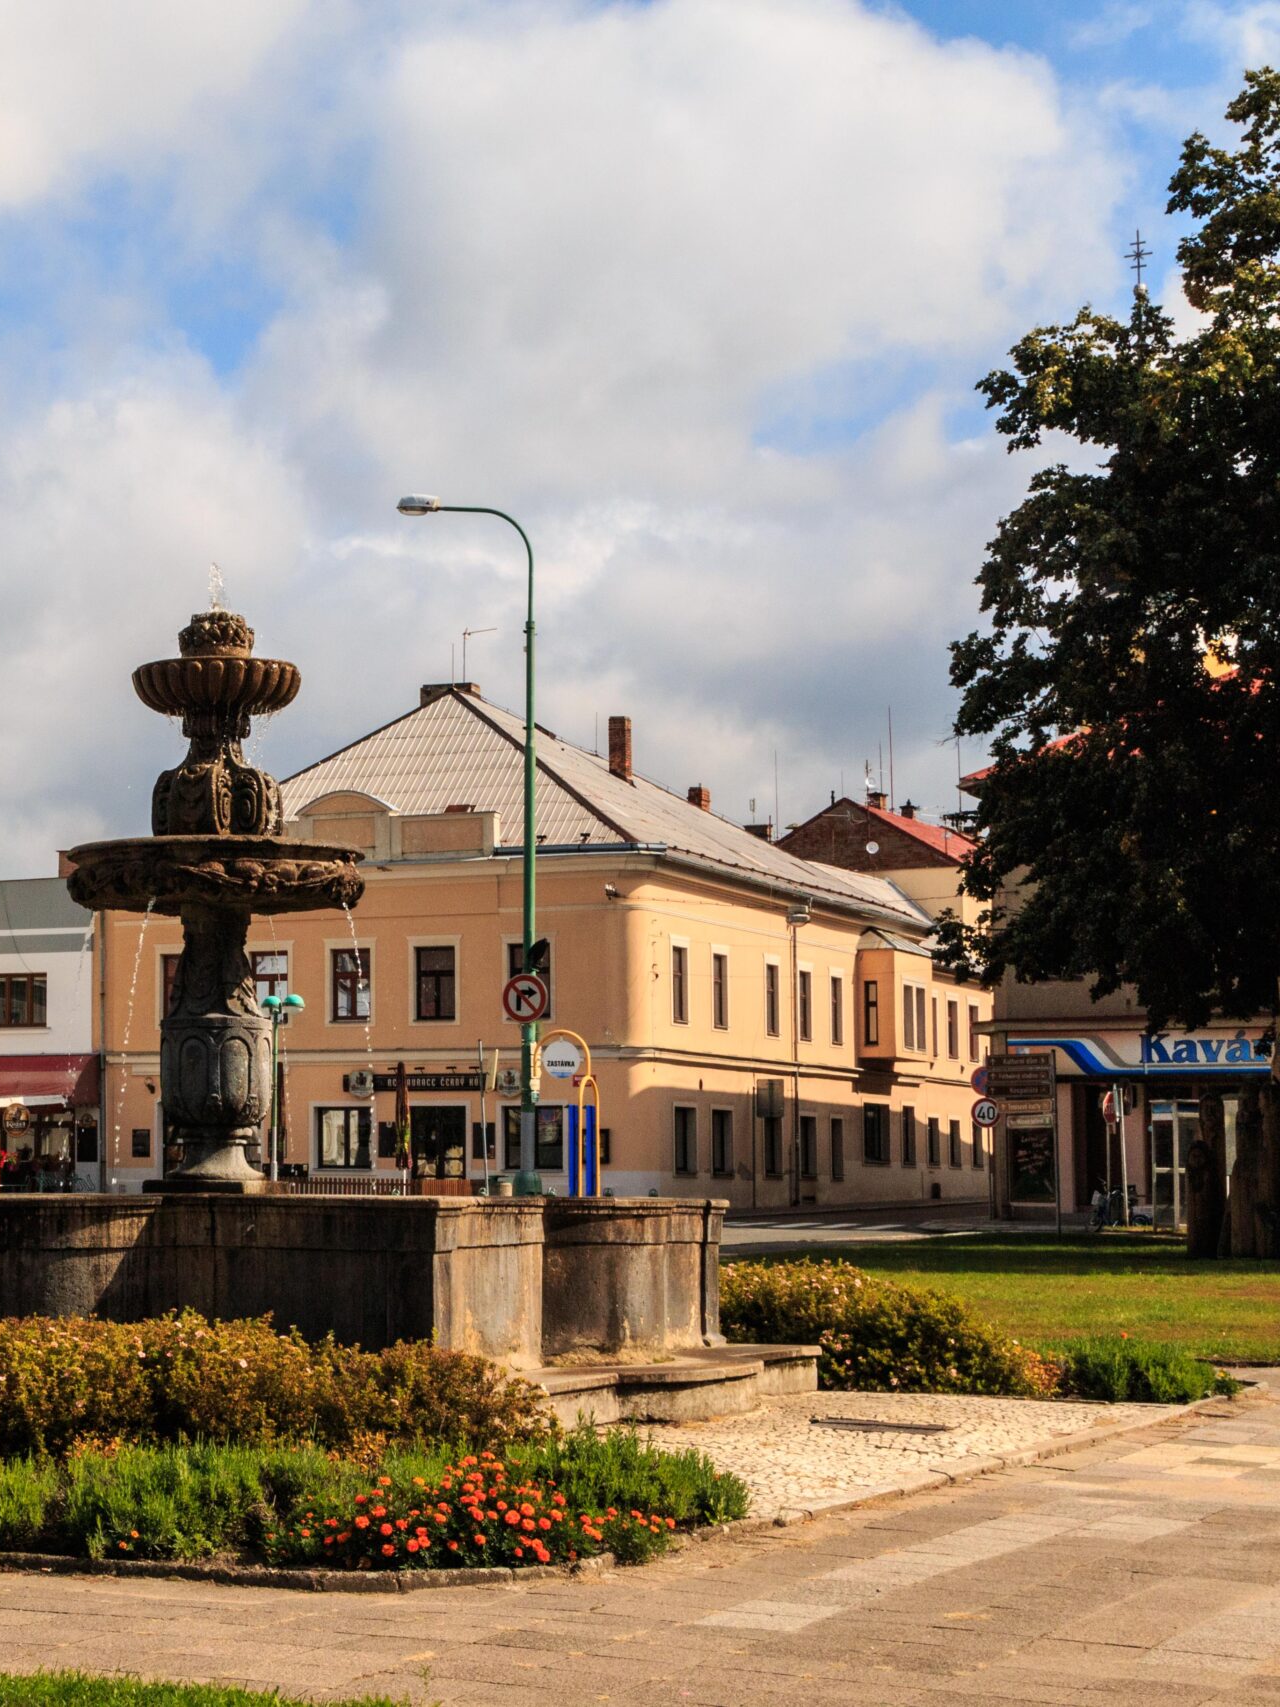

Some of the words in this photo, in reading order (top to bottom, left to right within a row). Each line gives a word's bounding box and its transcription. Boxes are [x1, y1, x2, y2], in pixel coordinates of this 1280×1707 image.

[387, 1077, 436, 1087] REAURACE
[469, 1076, 483, 1087] KŮ
[977, 1106, 995, 1120] 40
